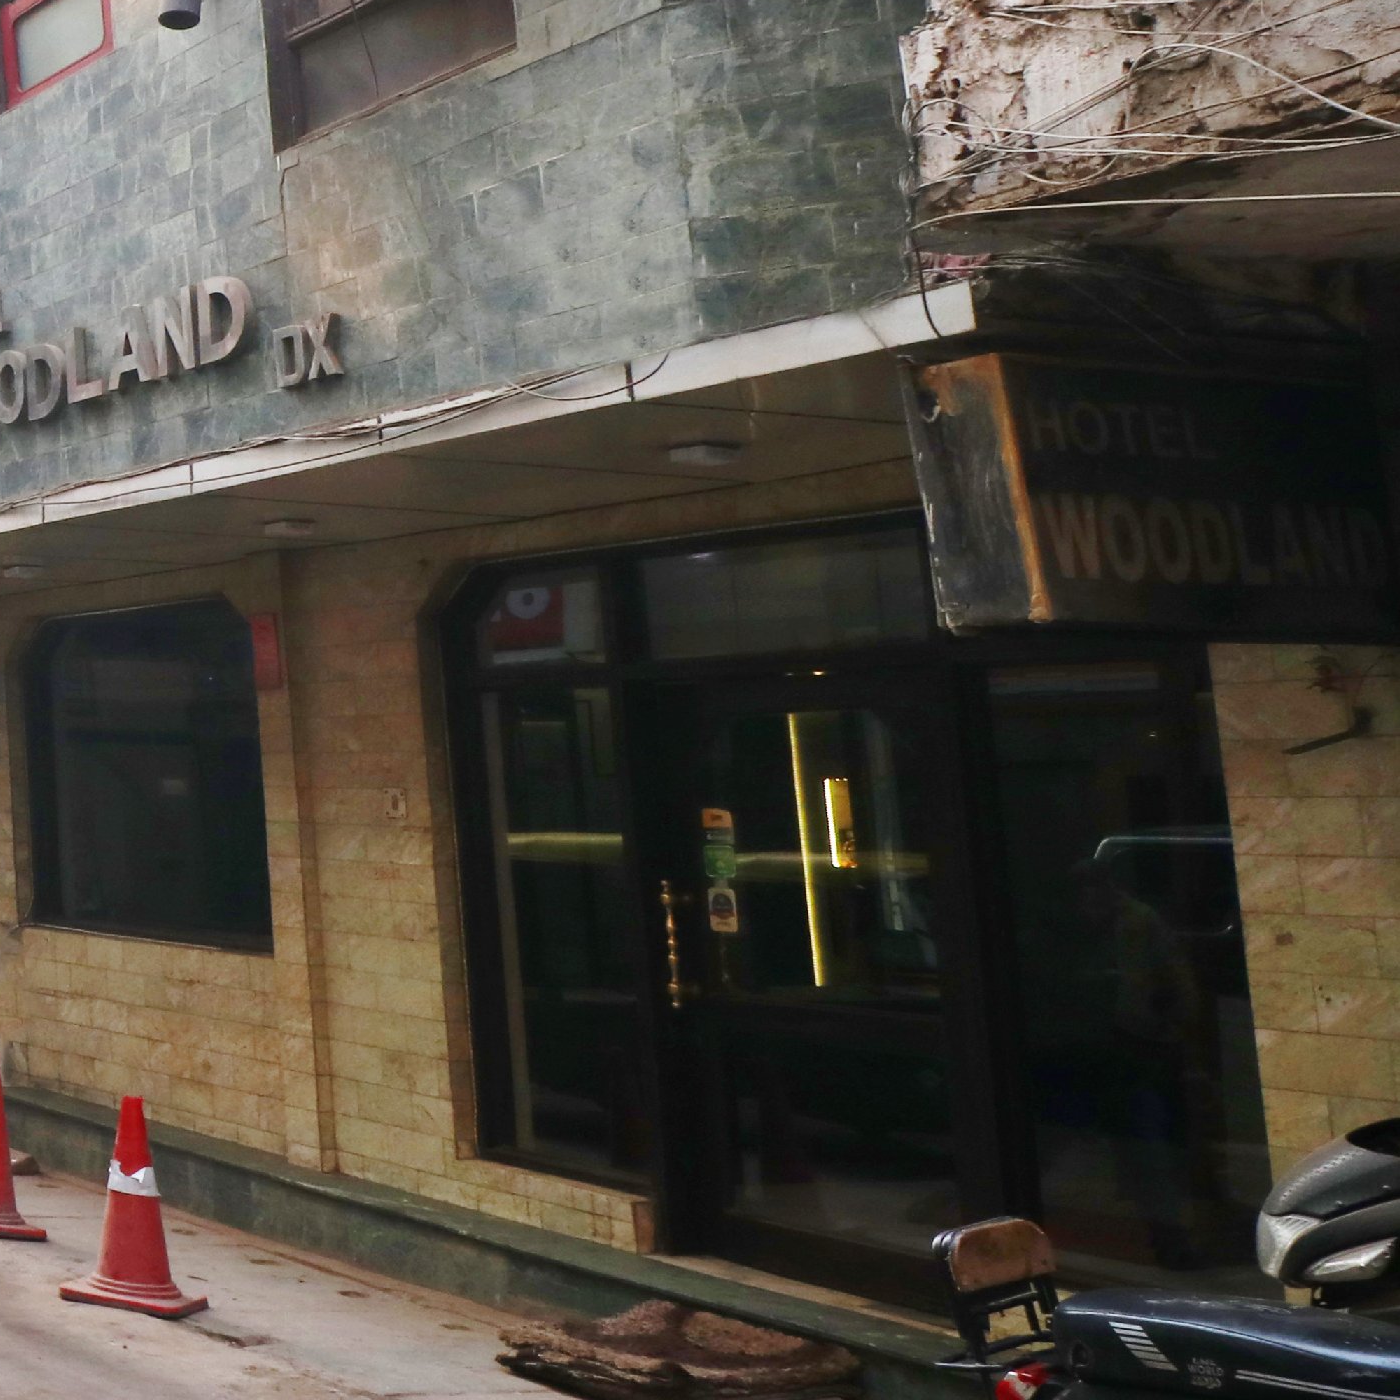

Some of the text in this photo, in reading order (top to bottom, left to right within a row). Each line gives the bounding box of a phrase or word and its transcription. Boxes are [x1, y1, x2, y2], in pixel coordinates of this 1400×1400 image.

[272, 312, 345, 388] DX
[1028, 401, 1221, 459] HOTEL
[1041, 493, 1383, 585] WOODLAND
